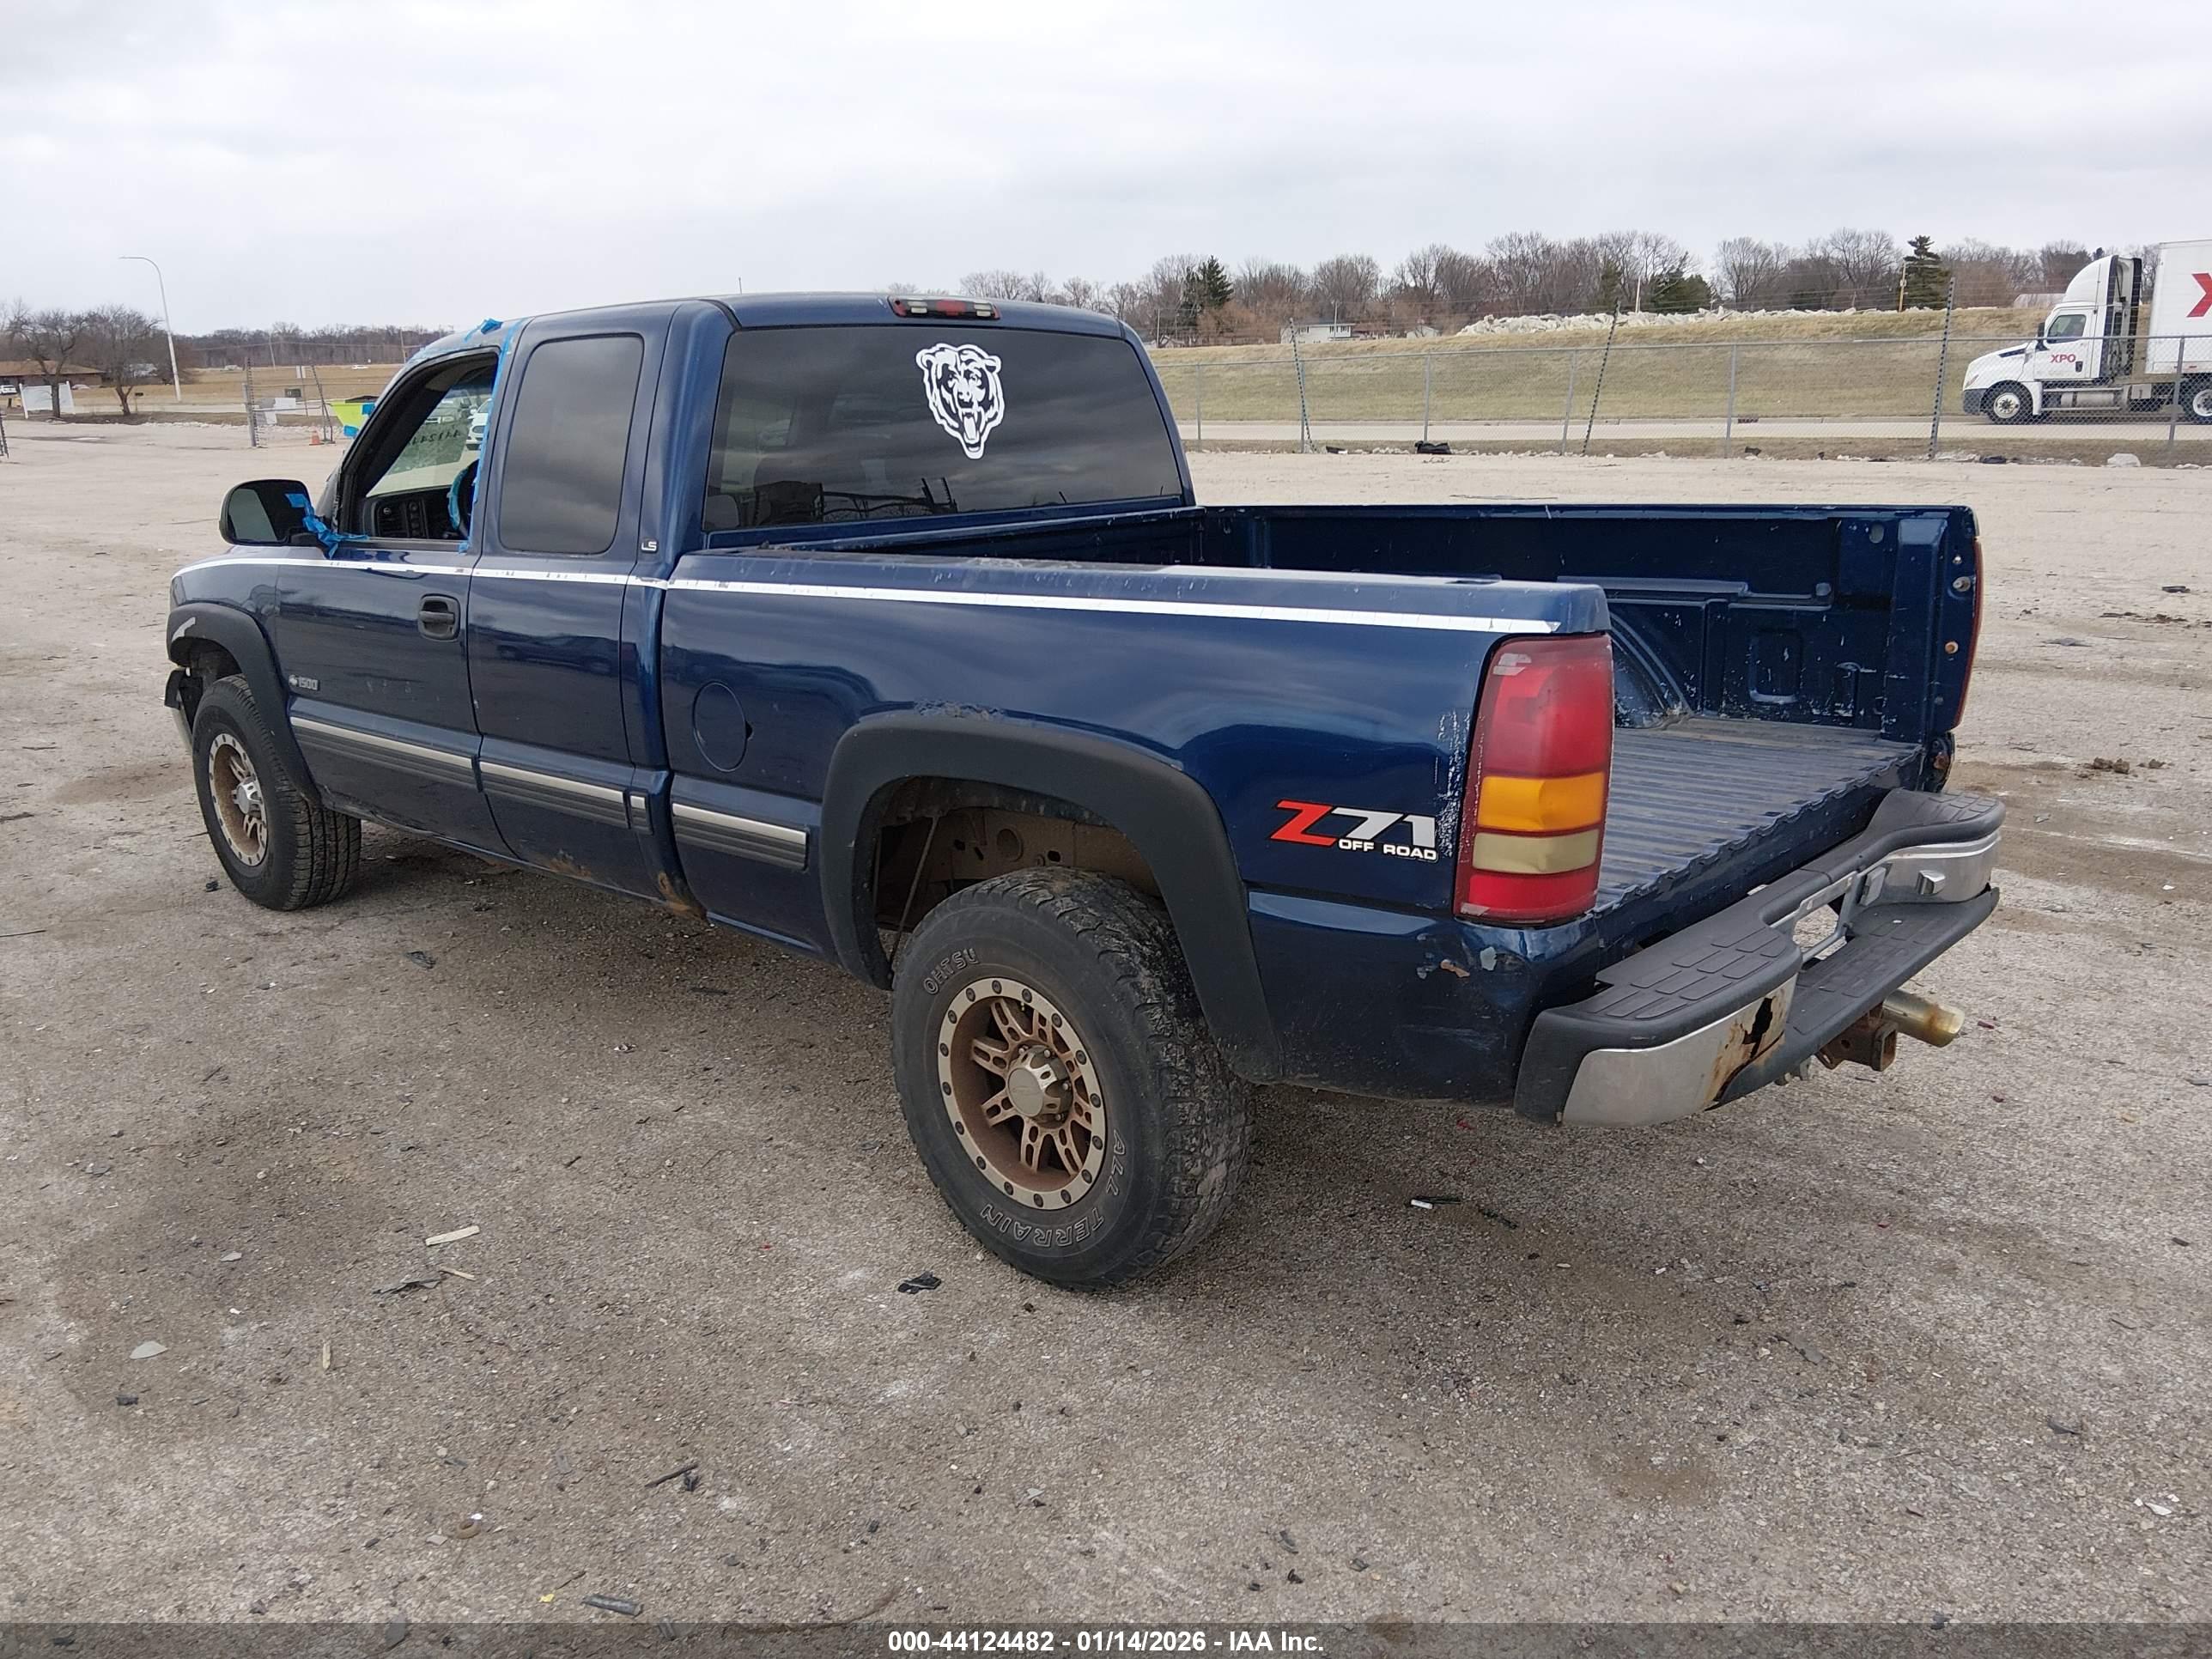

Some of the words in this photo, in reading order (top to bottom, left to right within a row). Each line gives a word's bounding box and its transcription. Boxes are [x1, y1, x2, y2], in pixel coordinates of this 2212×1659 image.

[2050, 354, 2076, 363] XPO
[641, 541, 657, 551] LS
[1270, 799, 1436, 847] Z71
[1338, 838, 1375, 853] OFF
[1382, 843, 1437, 861] ROAD
[923, 947, 980, 995] OHTSU
[1106, 1129, 1127, 1196] ALL
[979, 1204, 1105, 1248] TERRAIN
